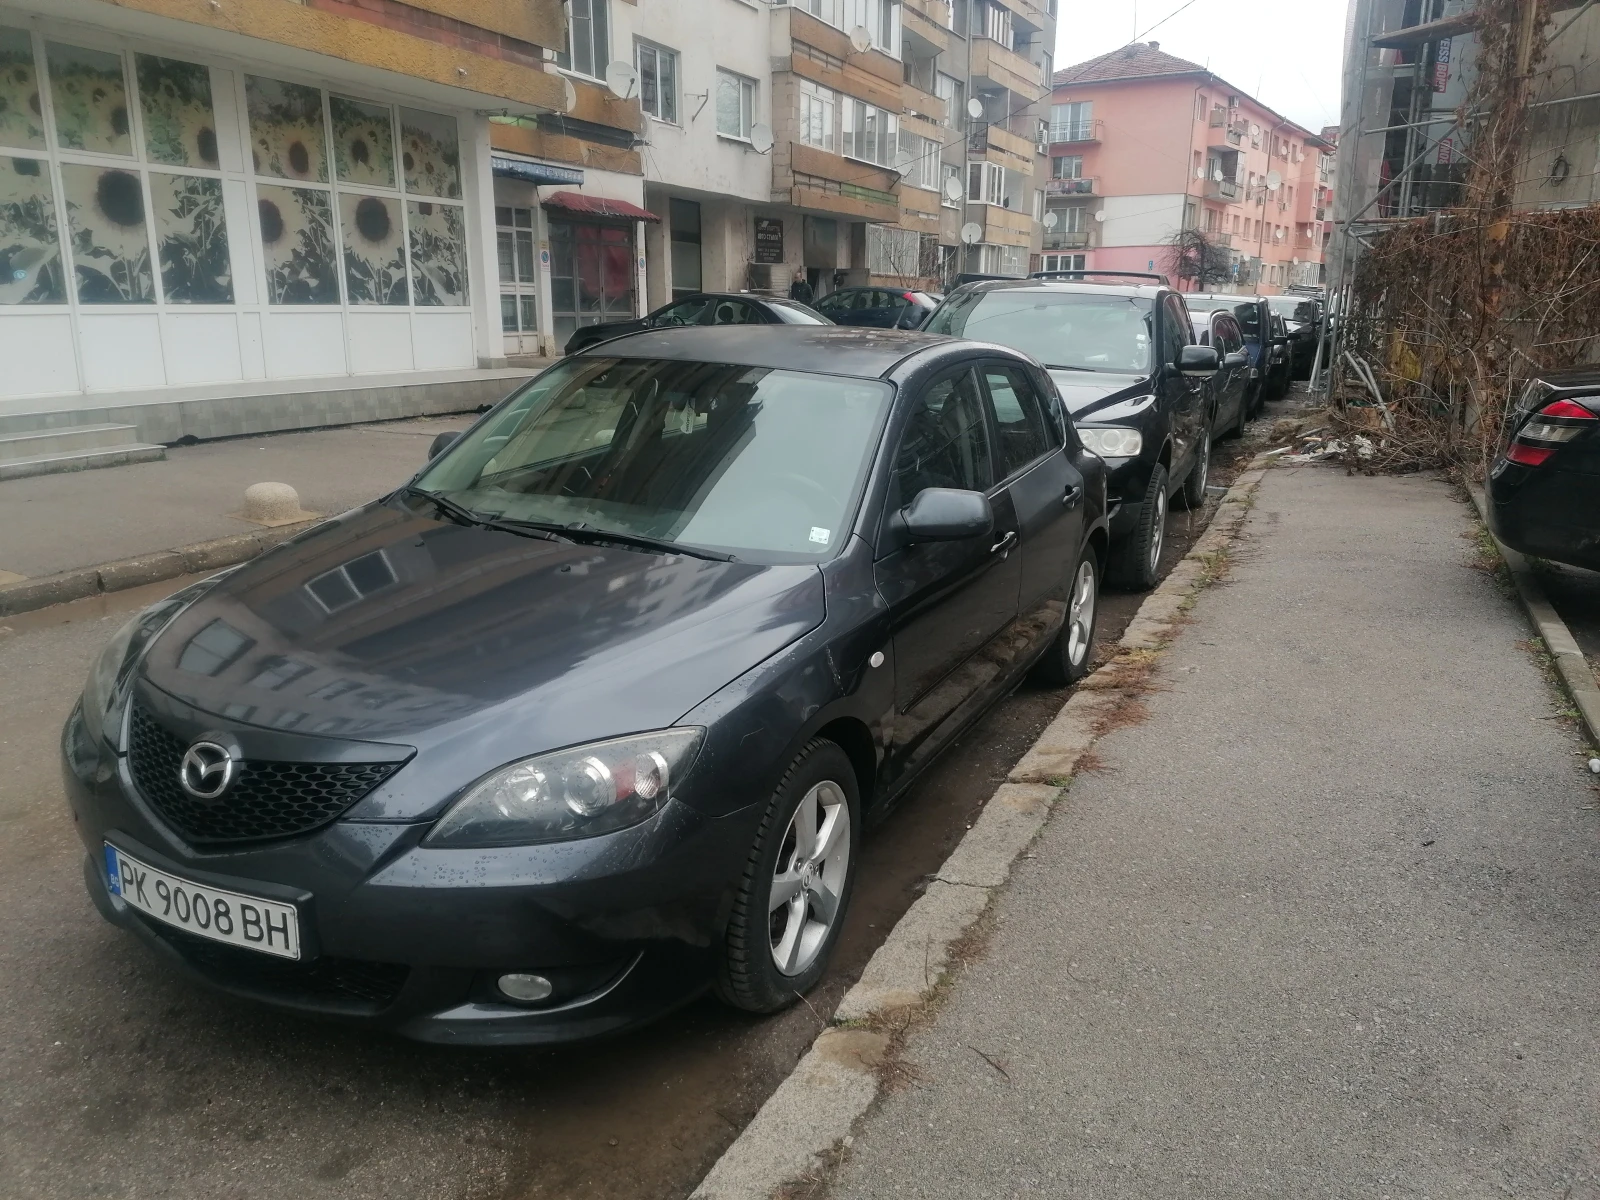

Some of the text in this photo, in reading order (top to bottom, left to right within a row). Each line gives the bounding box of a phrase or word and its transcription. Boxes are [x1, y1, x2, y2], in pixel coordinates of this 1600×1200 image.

[110, 874, 120, 887] BG
[119, 858, 290, 950] PK 9008 BH
